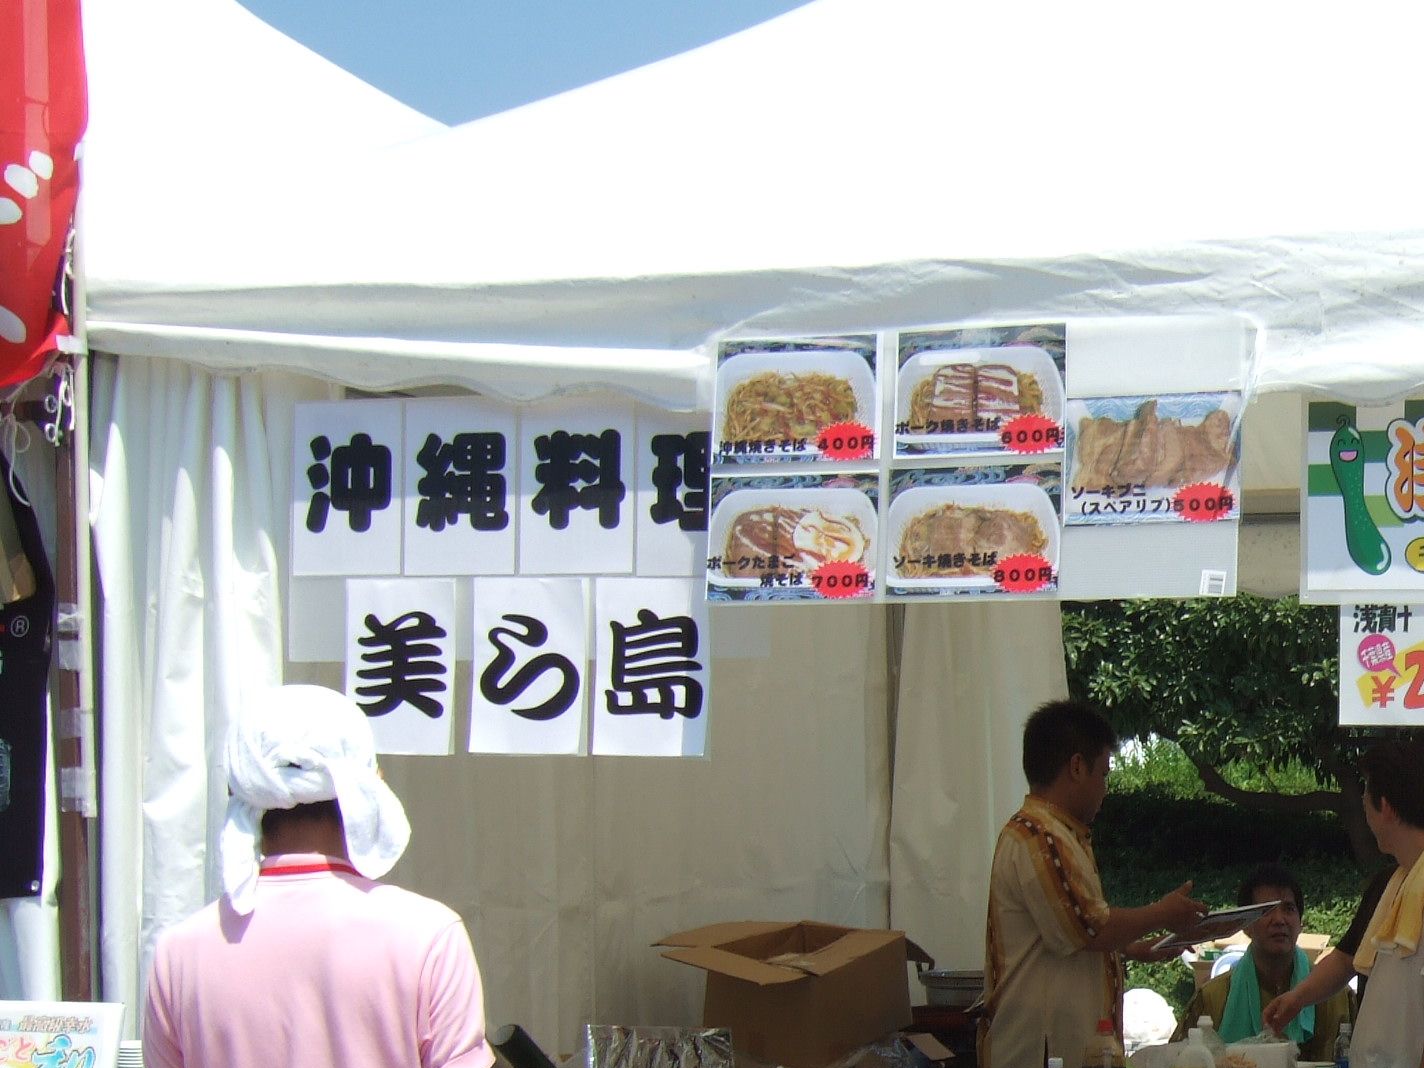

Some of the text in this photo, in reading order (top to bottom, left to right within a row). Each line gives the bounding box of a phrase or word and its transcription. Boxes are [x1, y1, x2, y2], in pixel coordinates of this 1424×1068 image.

[816, 433, 875, 453] 400円
[306, 429, 711, 533] 沖縄料理
[1172, 495, 1234, 513] 500円
[893, 550, 1053, 584] ソーキ焼きそば 800円
[759, 572, 870, 590] 焼そば 700円
[355, 608, 703, 721] 美ら島
